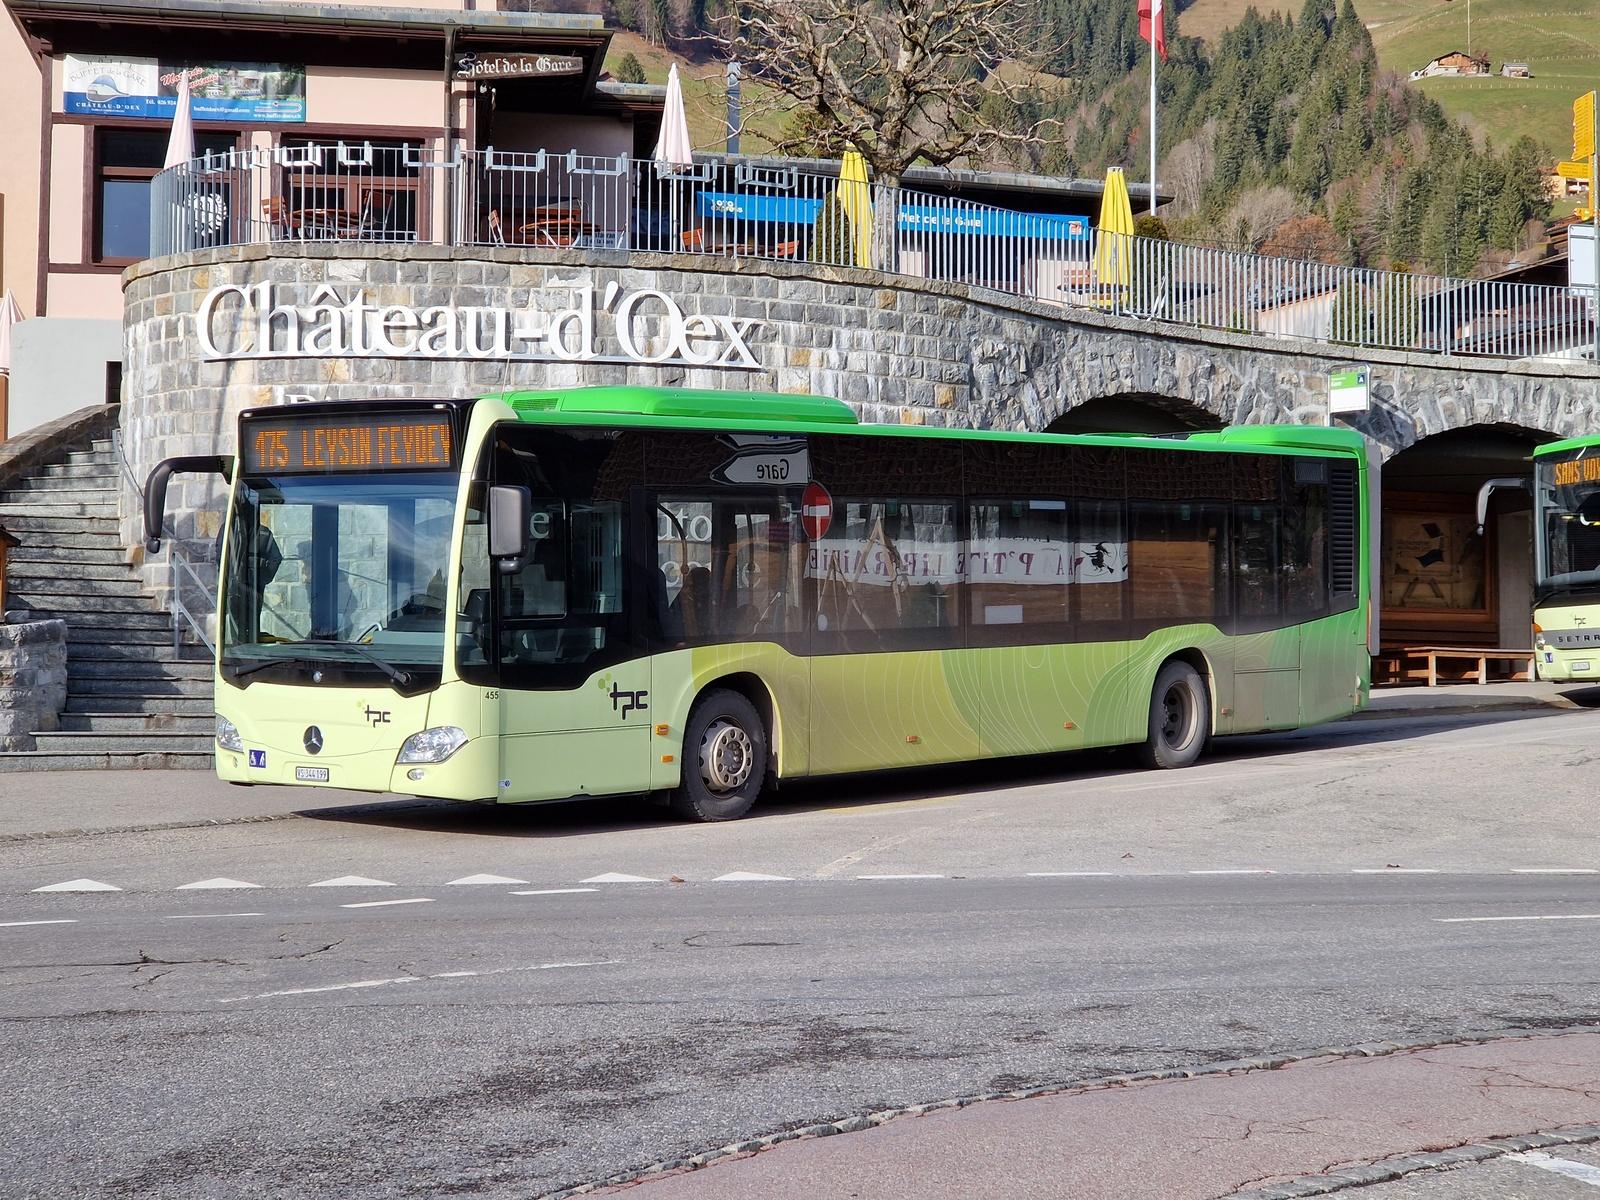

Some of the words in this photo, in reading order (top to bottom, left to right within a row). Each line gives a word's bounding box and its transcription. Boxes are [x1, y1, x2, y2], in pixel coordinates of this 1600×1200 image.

[457, 52, 500, 78] Hôtel
[502, 58, 517, 73] de
[519, 58, 533, 73] la
[535, 56, 572, 73] Gare
[197, 279, 762, 369] Château-d'Oex
[255, 430, 290, 467] 175
[303, 427, 371, 466] LEYSIN
[1555, 461, 1580, 485] SANS
[484, 691, 499, 700] 455
[609, 681, 648, 721] tpc
[364, 704, 391, 728] tpc
